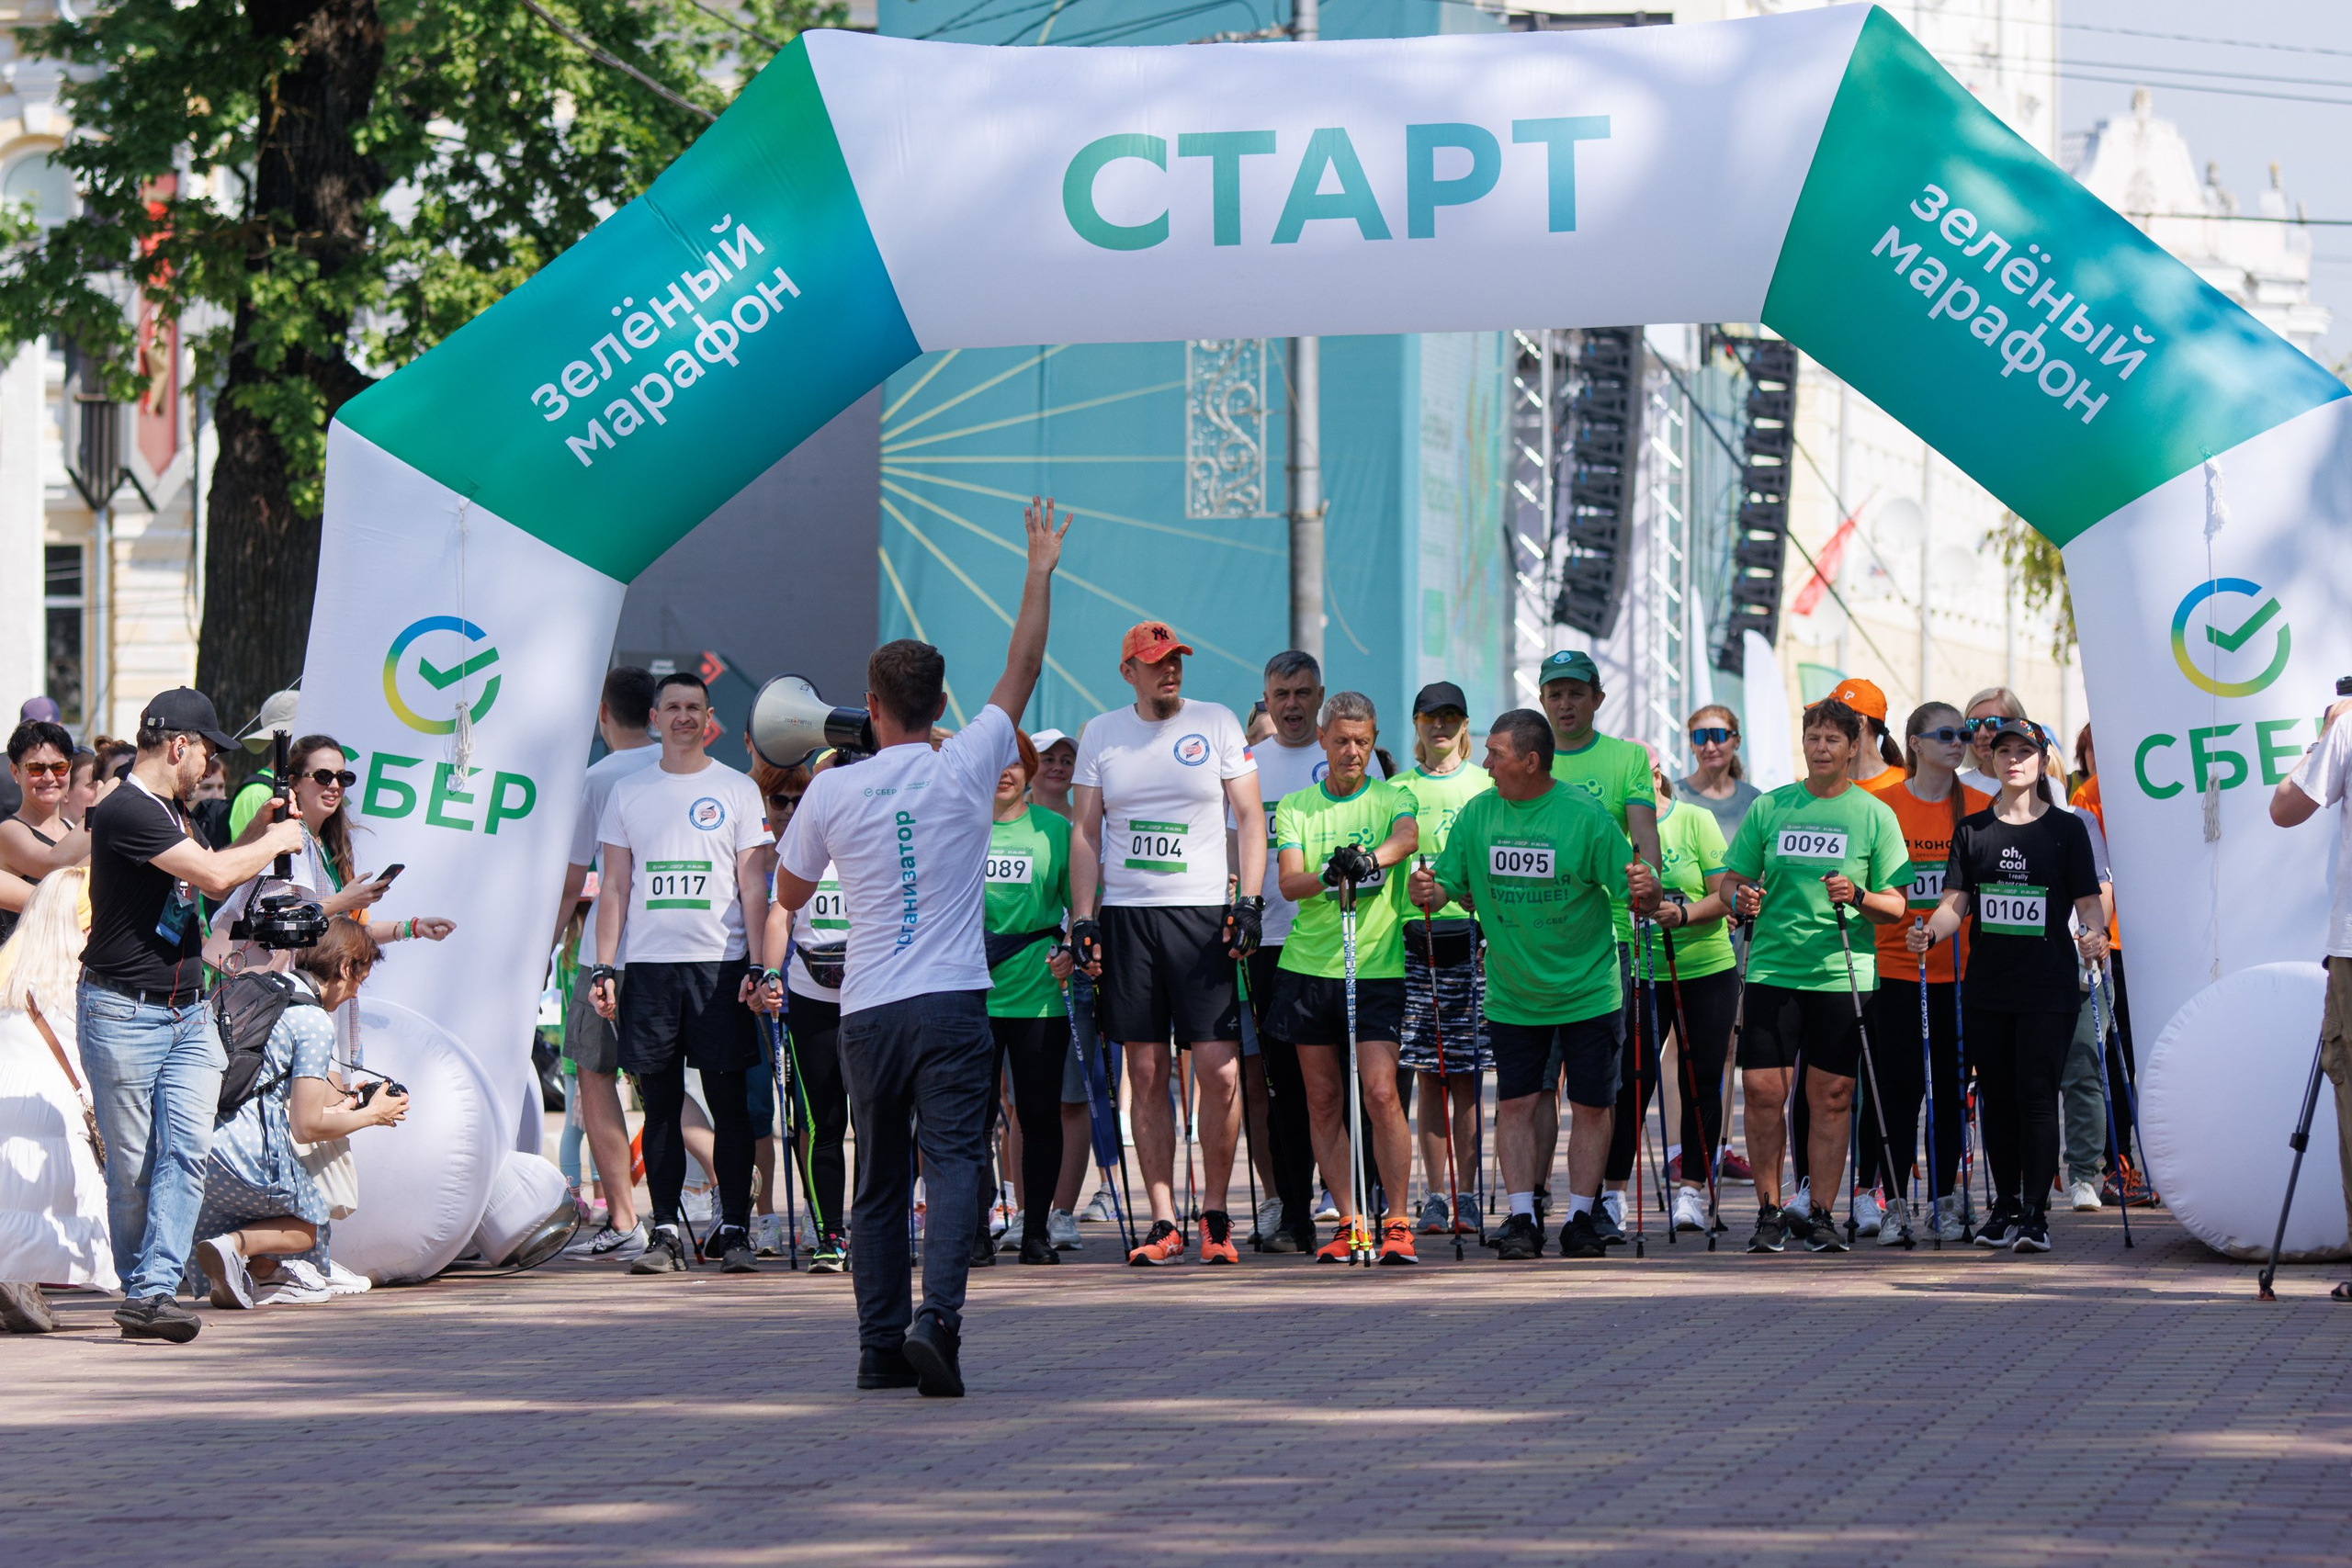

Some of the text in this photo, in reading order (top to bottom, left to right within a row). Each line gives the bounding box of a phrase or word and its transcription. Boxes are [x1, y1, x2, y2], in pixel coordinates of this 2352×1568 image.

[1062, 114, 1611, 252] СТАРТ
[1909, 183, 2156, 381] зелёный
[530, 212, 765, 422] зелёный
[1870, 224, 2110, 425] марафон
[564, 265, 802, 468] марафон
[2133, 716, 2324, 800] СБЕ
[1132, 835, 1182, 858] 0104
[1783, 834, 1840, 854] 0096
[2001, 846, 2023, 860] oh,
[1495, 851, 1549, 874] 0095
[1999, 858, 2027, 871] cool
[651, 875, 707, 896] 0117
[1490, 887, 1569, 905] БУДУЩЕЕ!
[816, 895, 848, 916] 01
[1985, 898, 2040, 921] 0106
[1545, 915, 1569, 926] СБЕР
